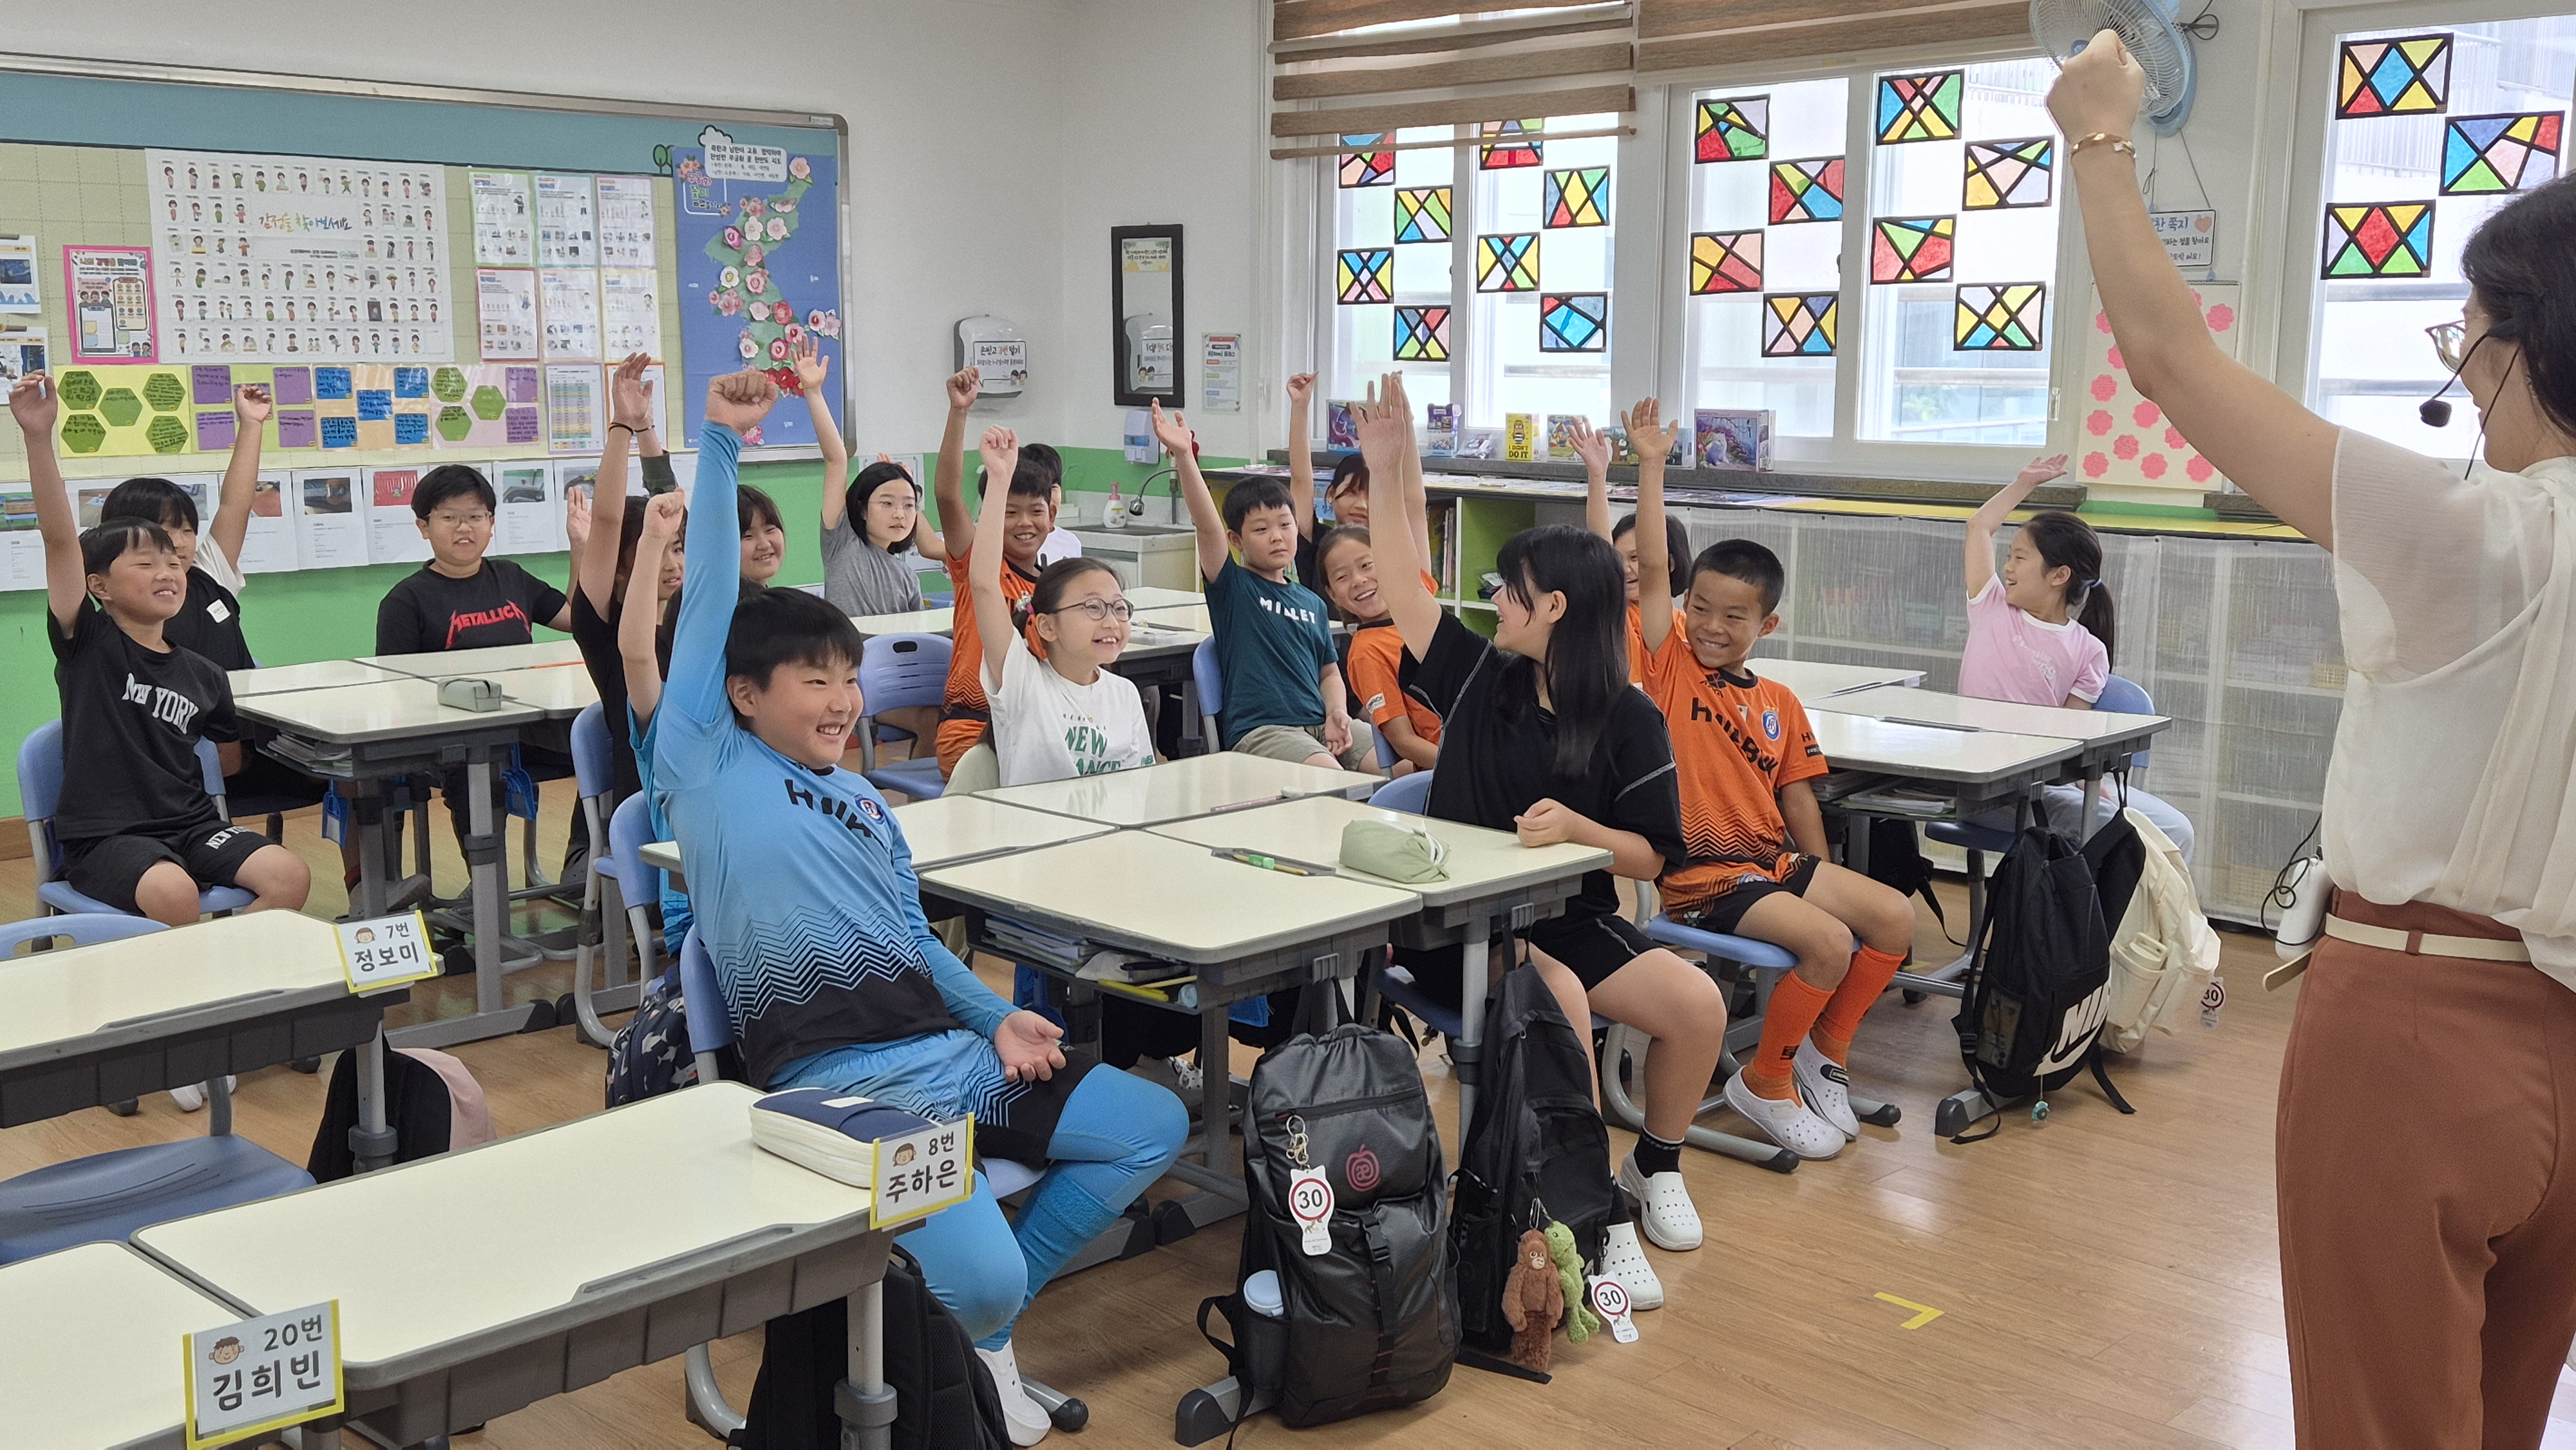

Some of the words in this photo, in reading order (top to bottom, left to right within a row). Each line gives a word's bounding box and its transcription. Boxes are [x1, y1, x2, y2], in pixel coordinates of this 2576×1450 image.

[2168, 216, 2189, 231] 쪽지
[1509, 450, 1519, 458] DO
[444, 599, 532, 650] METALLICA
[152, 686, 200, 735] YORK
[1065, 726, 1108, 758] NEW
[385, 922, 410, 939] 7번
[355, 941, 419, 972] 정보미
[929, 1131, 954, 1156] 8번
[886, 1159, 958, 1204] 주하은
[1298, 1189, 1323, 1209] 30
[1600, 1290, 1621, 1306] 30
[264, 1313, 323, 1351] 20번
[213, 1350, 321, 1411] 김희빈
